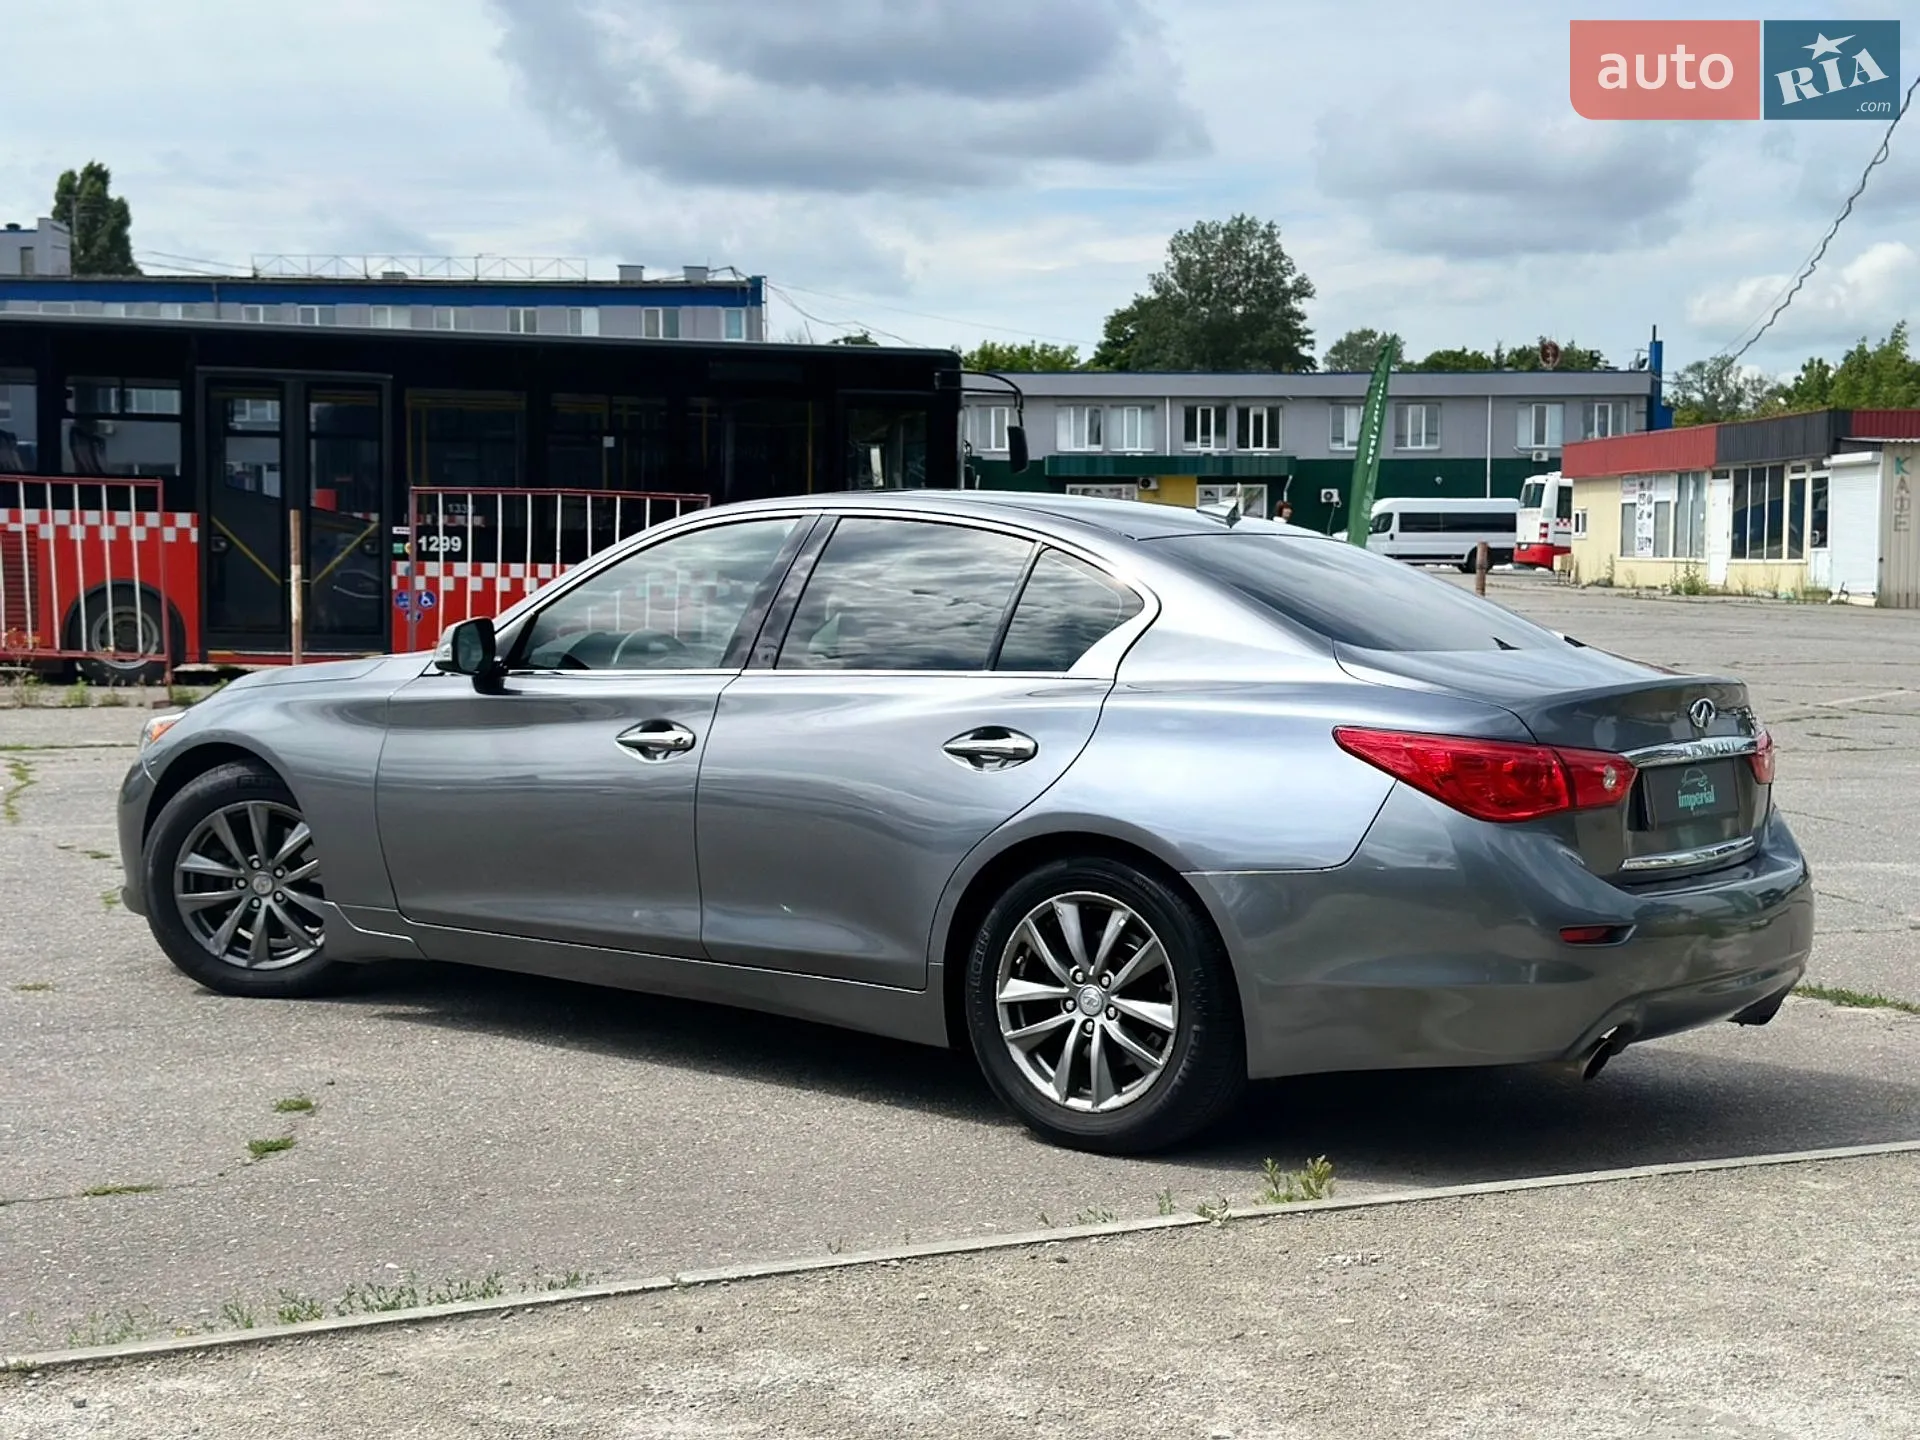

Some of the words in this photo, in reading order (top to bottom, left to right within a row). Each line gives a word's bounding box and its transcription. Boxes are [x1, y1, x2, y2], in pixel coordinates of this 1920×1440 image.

[1894, 456, 1911, 532] КАФЕ
[418, 535, 462, 552] 1299
[1677, 784, 1716, 811] imperial
